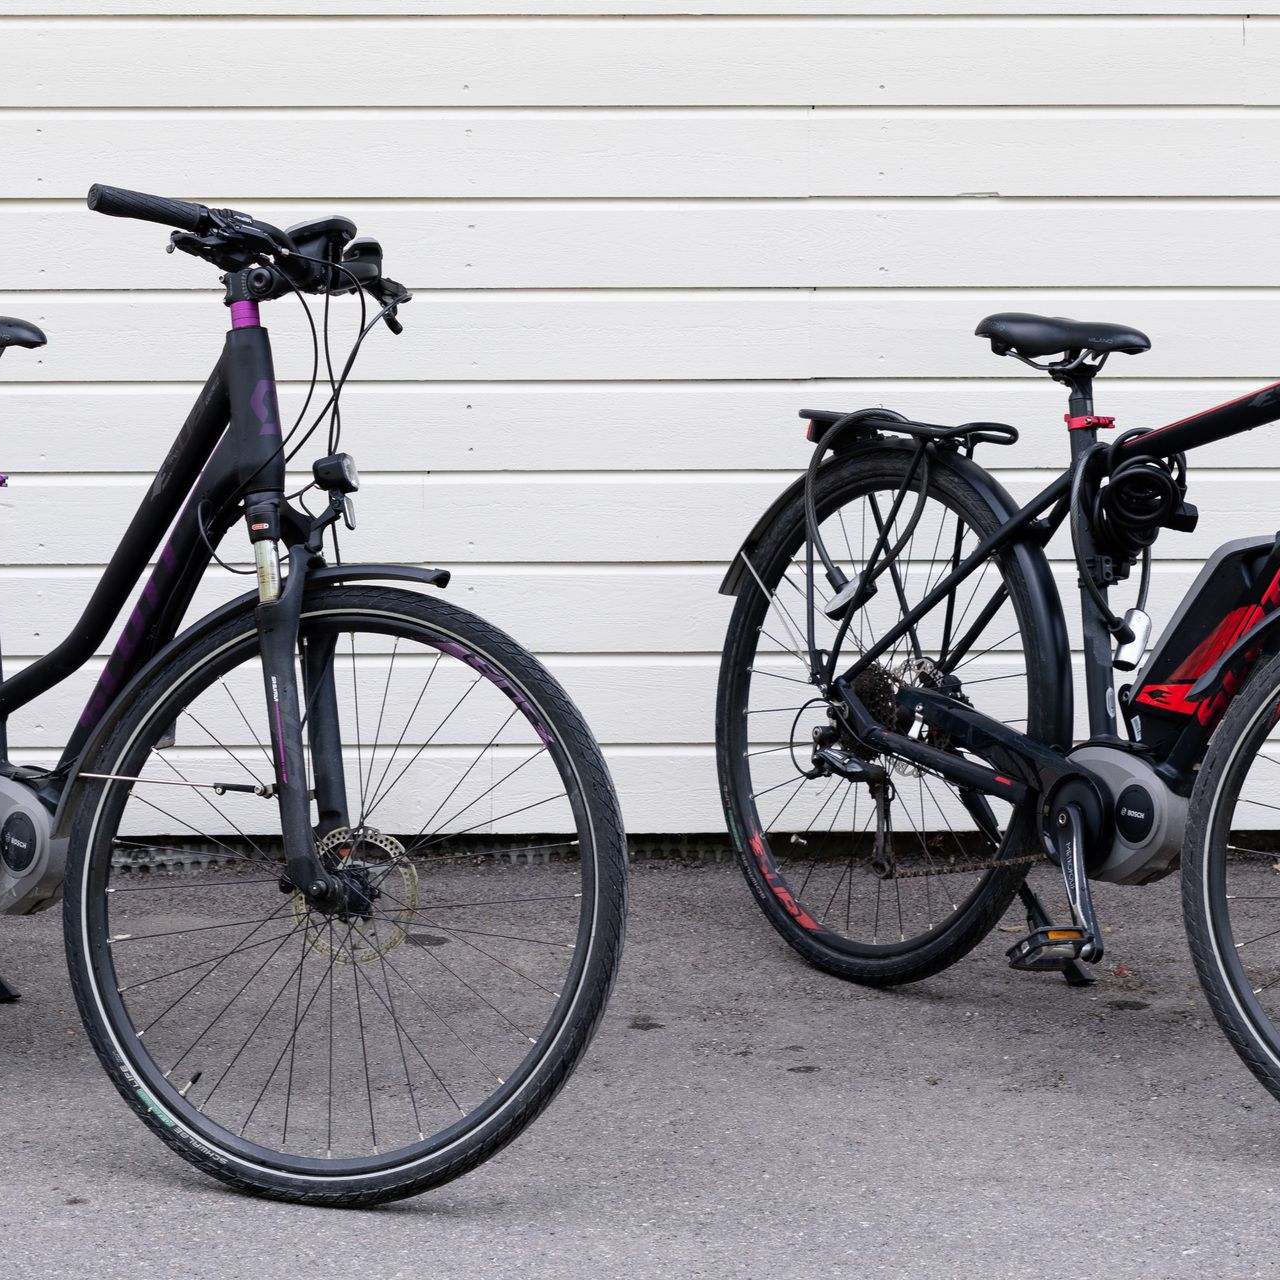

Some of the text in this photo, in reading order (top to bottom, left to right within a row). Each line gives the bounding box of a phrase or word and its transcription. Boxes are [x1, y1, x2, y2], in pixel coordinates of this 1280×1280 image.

[1127, 809, 1145, 819] BOSCH
[11, 837, 27, 849] BOSCH
[119, 1065, 140, 1089] LIFE
[173, 1126, 229, 1165] SCHWALBE
